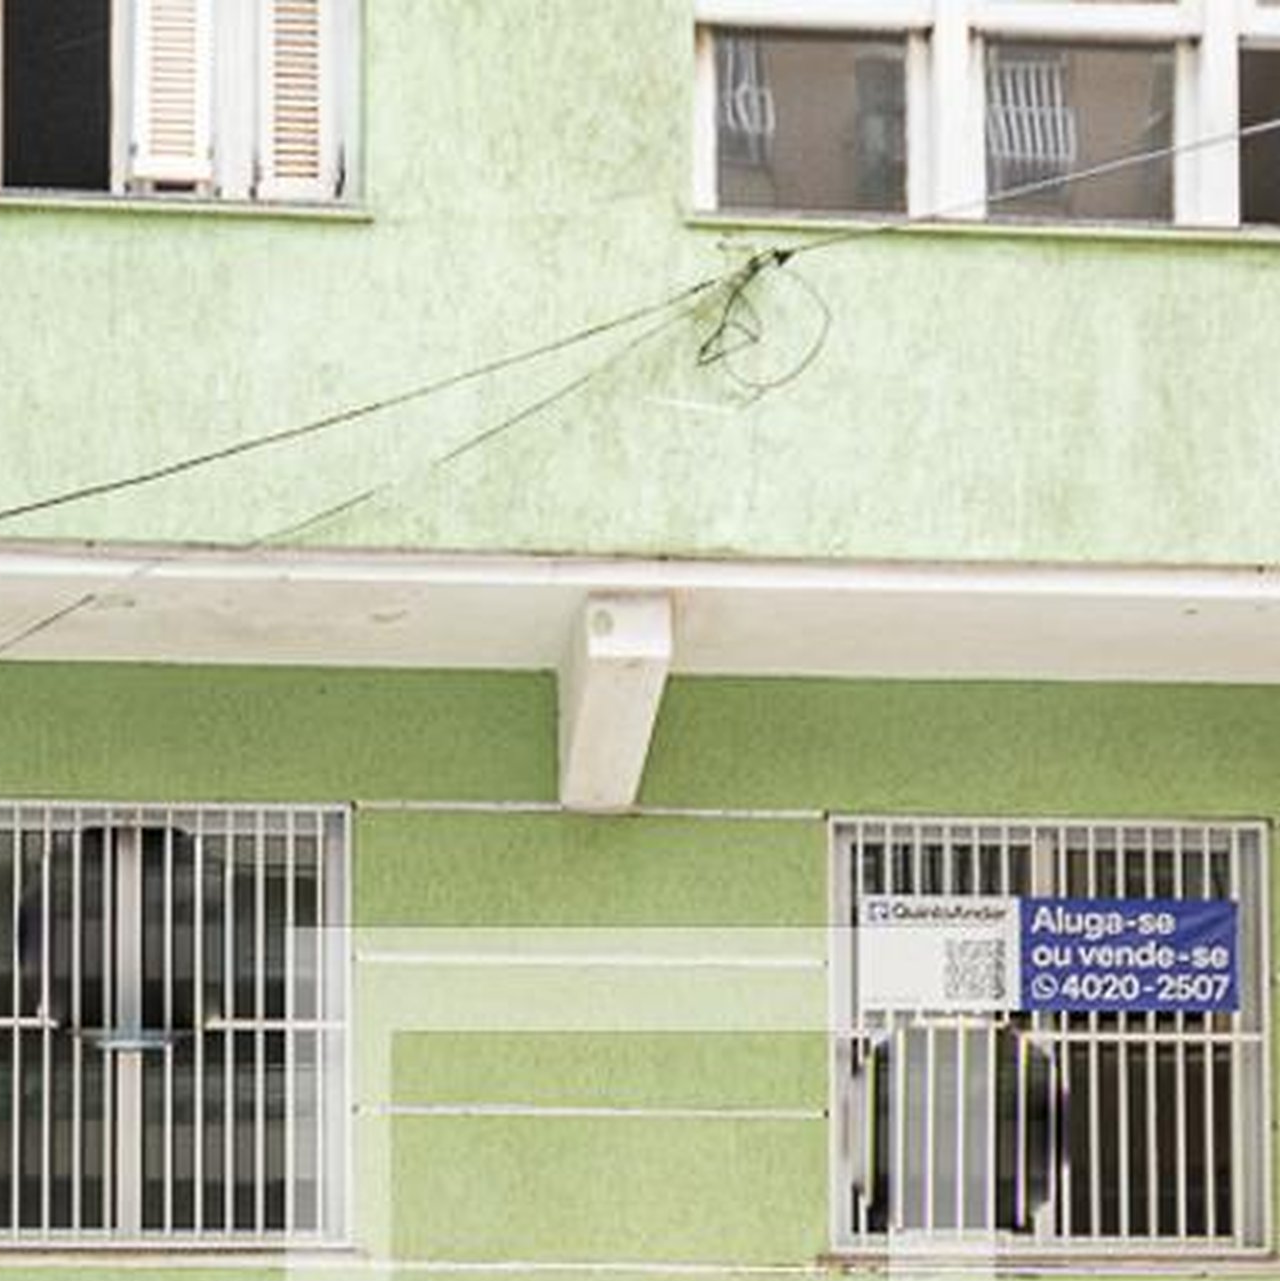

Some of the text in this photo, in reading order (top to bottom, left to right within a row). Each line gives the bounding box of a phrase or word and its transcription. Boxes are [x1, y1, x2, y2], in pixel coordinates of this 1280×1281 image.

[1031, 906, 1176, 938] Aluga-se
[1032, 943, 1230, 969] ou vende-se
[1060, 974, 1230, 1001] 4020-2507
